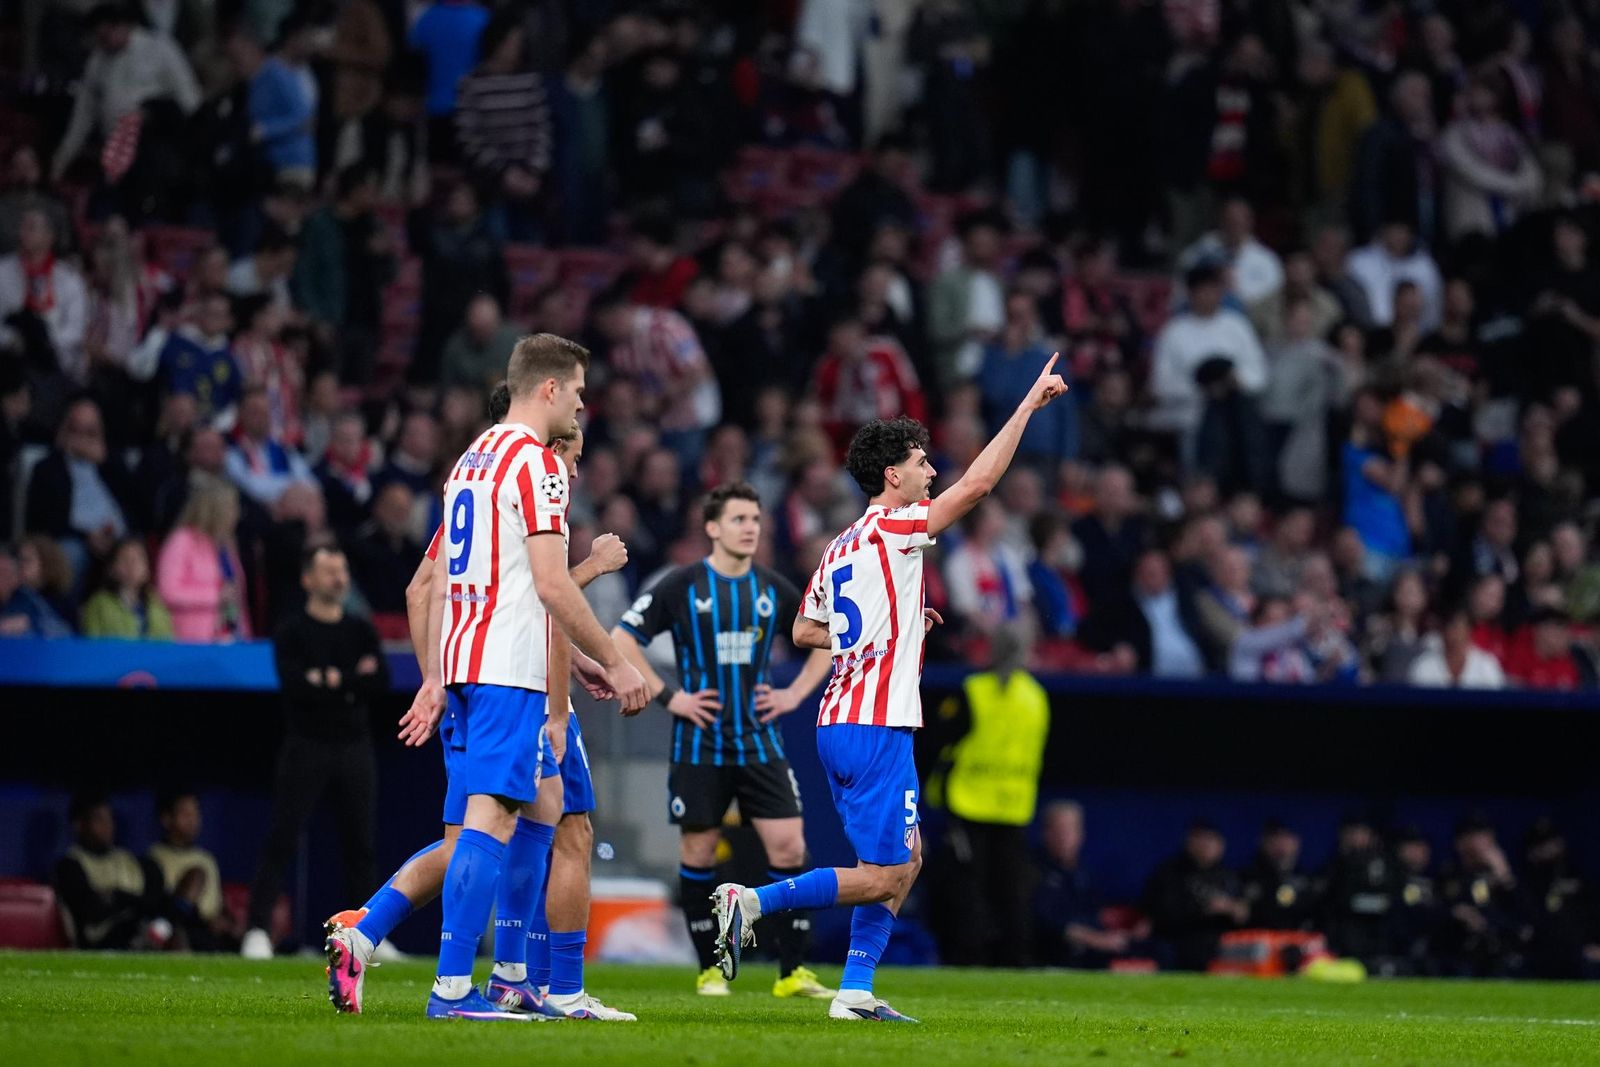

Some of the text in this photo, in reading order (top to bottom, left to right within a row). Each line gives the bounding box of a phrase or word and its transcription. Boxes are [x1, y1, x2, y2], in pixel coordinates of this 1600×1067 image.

[449, 488, 474, 576] 9
[832, 563, 863, 650] 5
[904, 790, 917, 825] 5
